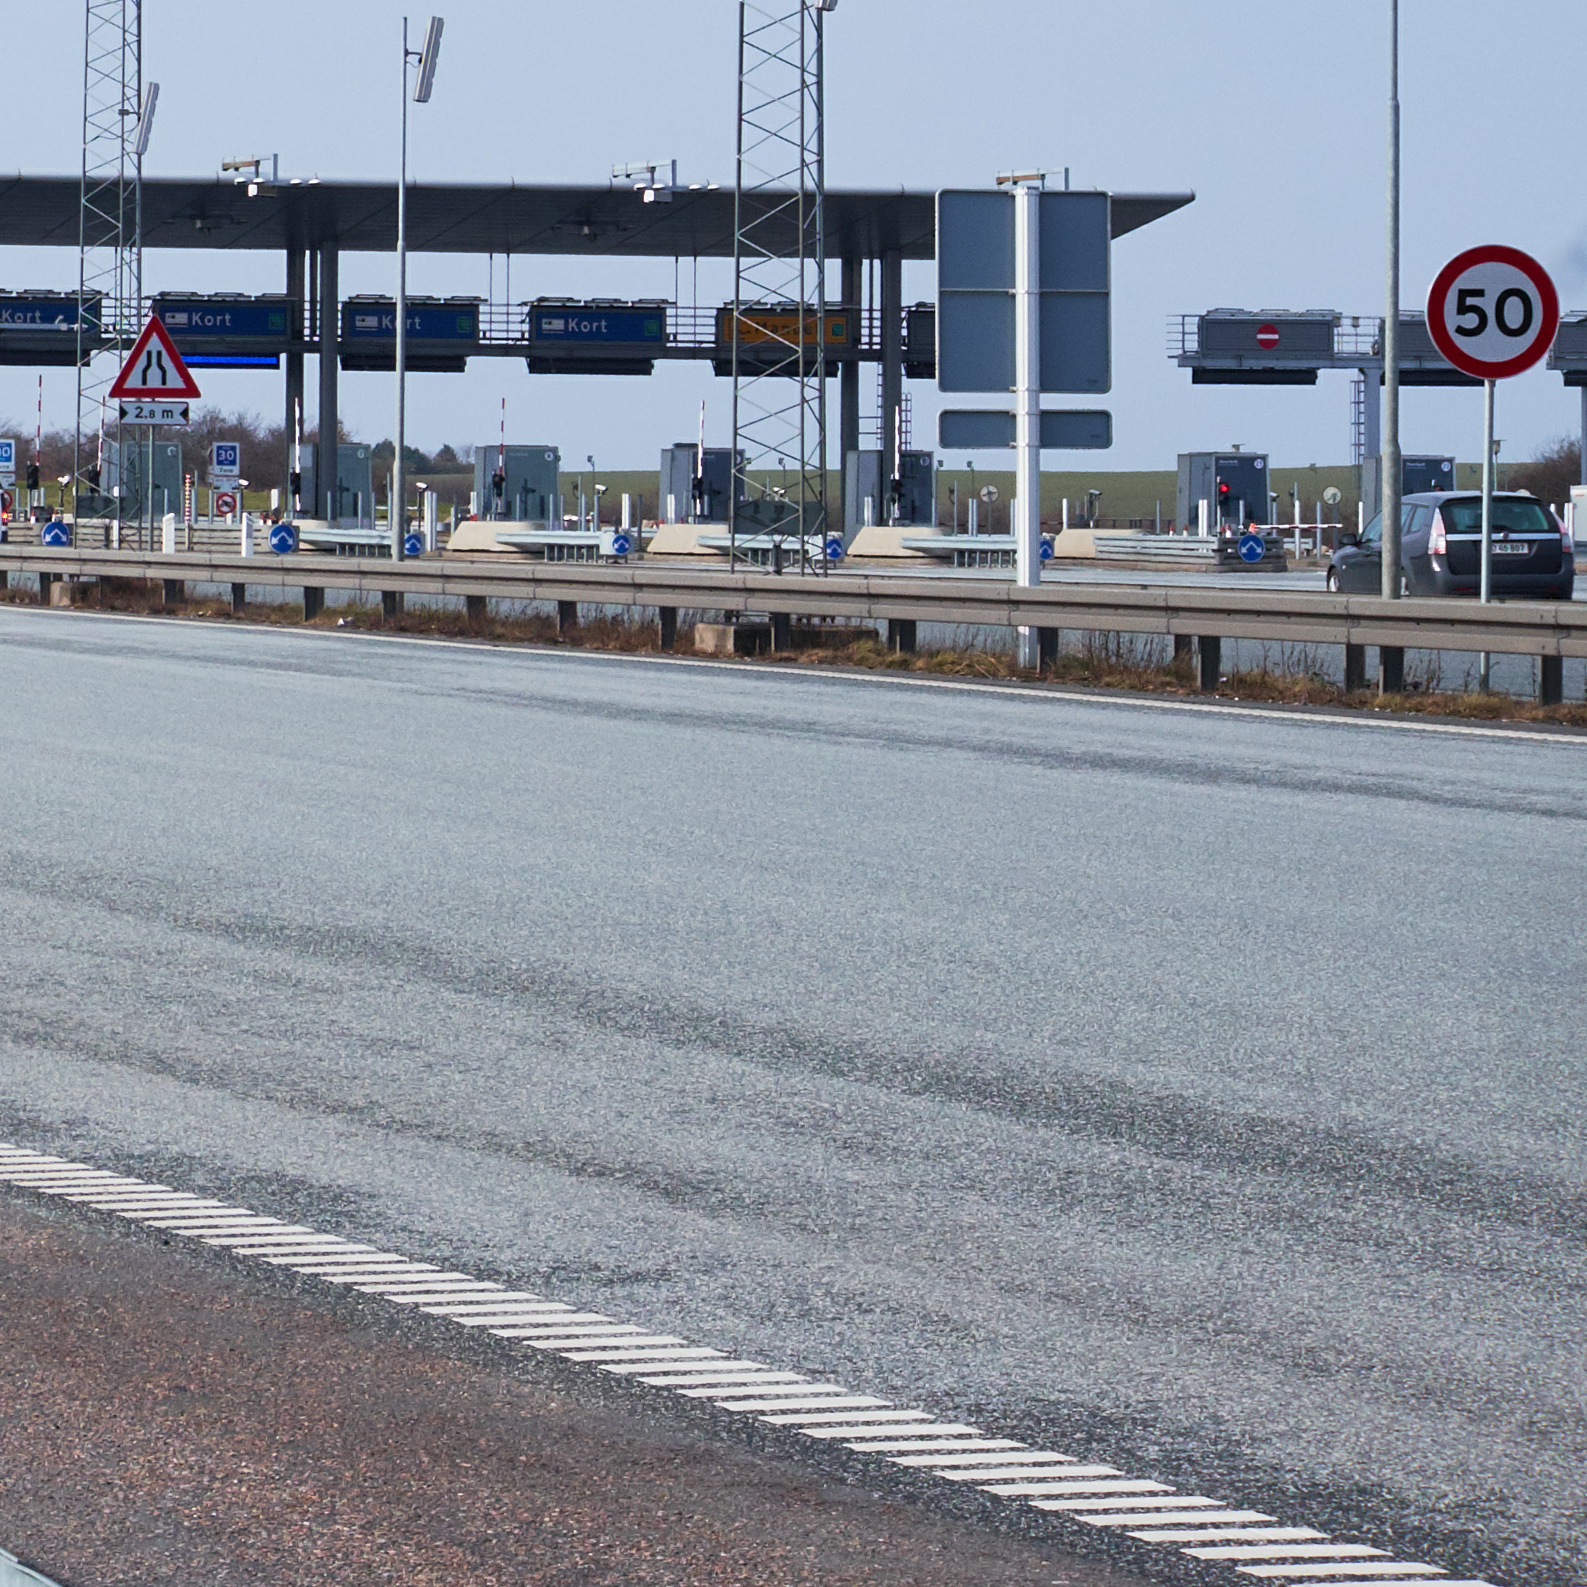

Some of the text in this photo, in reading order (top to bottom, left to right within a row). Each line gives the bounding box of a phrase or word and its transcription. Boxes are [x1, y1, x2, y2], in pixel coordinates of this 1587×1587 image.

[2, 309, 41, 324] Kort
[191, 311, 231, 327] Kort
[1454, 287, 1533, 338] 50
[381, 314, 421, 330] Krt
[567, 317, 607, 333] Kort
[161, 409, 174, 420] m
[218, 449, 235, 461] 30
